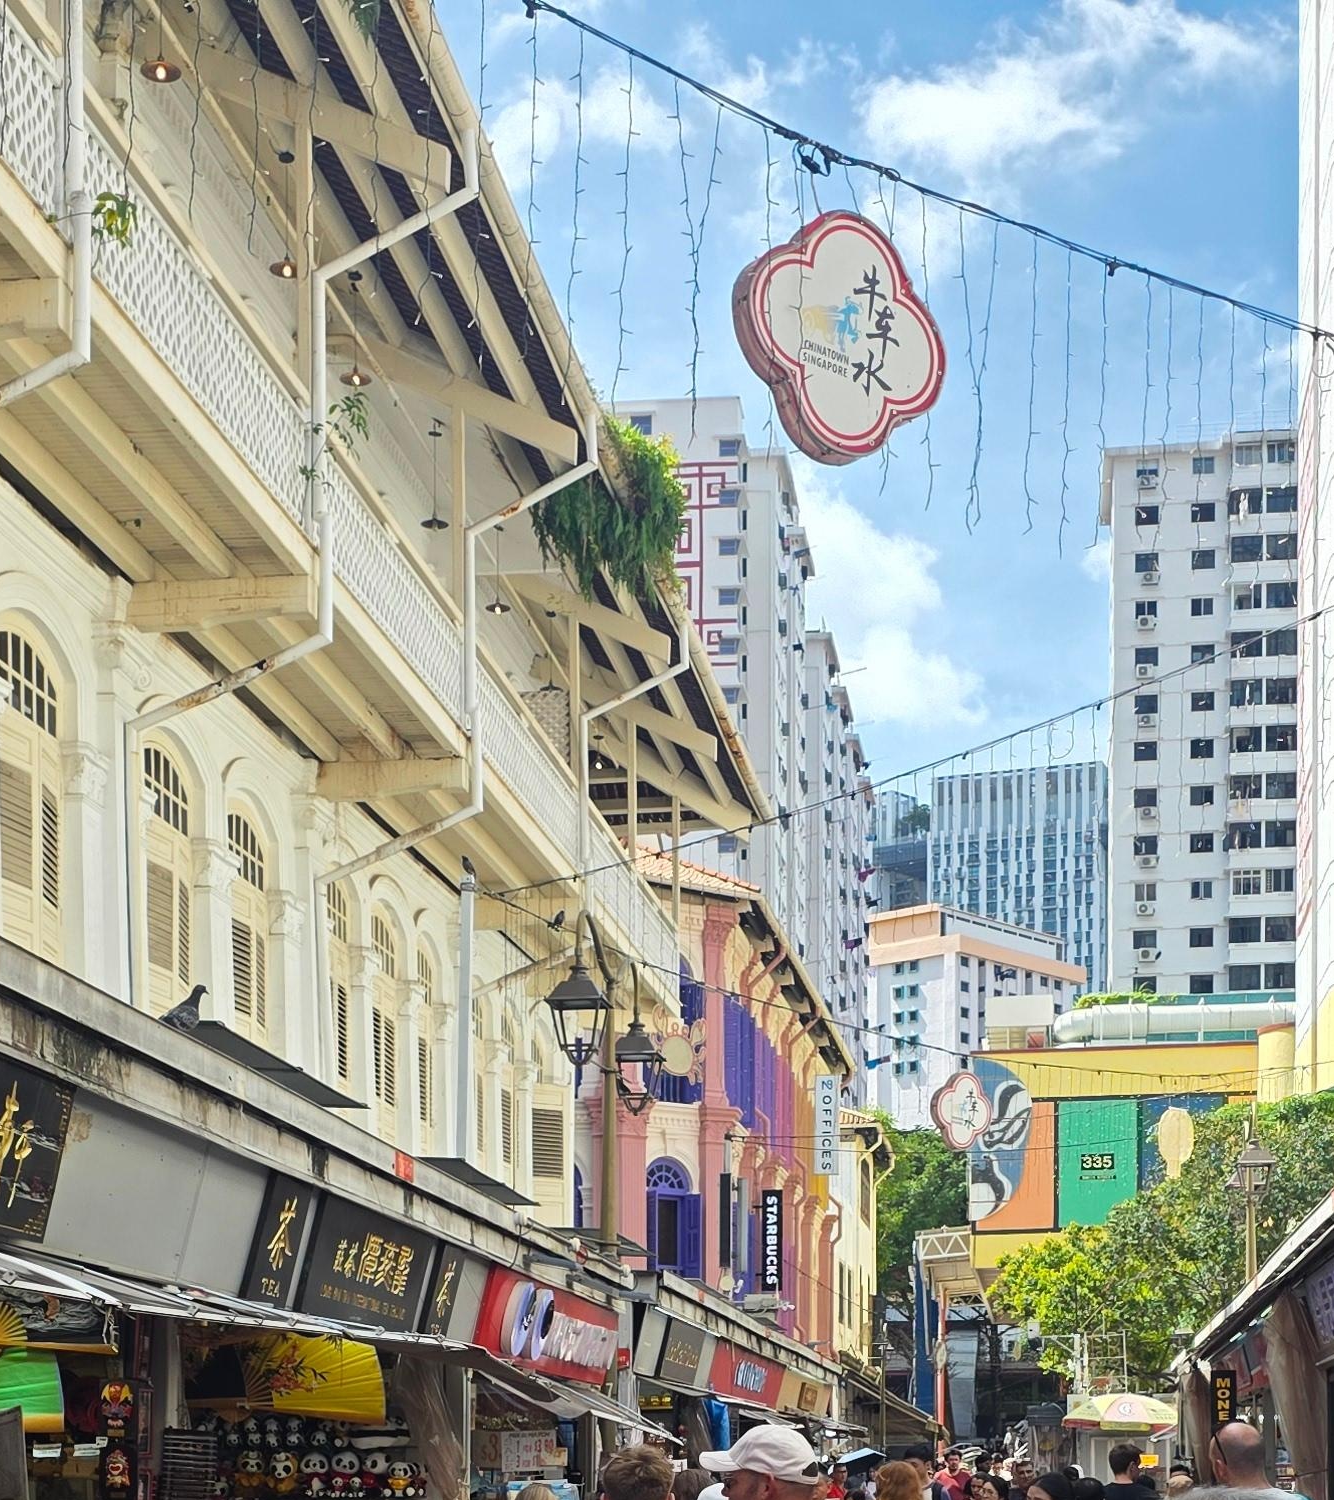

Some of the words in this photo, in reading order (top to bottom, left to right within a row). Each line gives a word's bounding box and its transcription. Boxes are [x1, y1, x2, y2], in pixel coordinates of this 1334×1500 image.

[802, 352, 848, 378] SINGAPORE
[803, 339, 849, 366] CHINATOWN
[821, 1095, 832, 1170] OFFICES
[1082, 1155, 1113, 1169] 335
[766, 1196, 778, 1285] STARBUCKS
[261, 1278, 281, 1298] TEA
[1216, 1378, 1231, 1421] MONE
